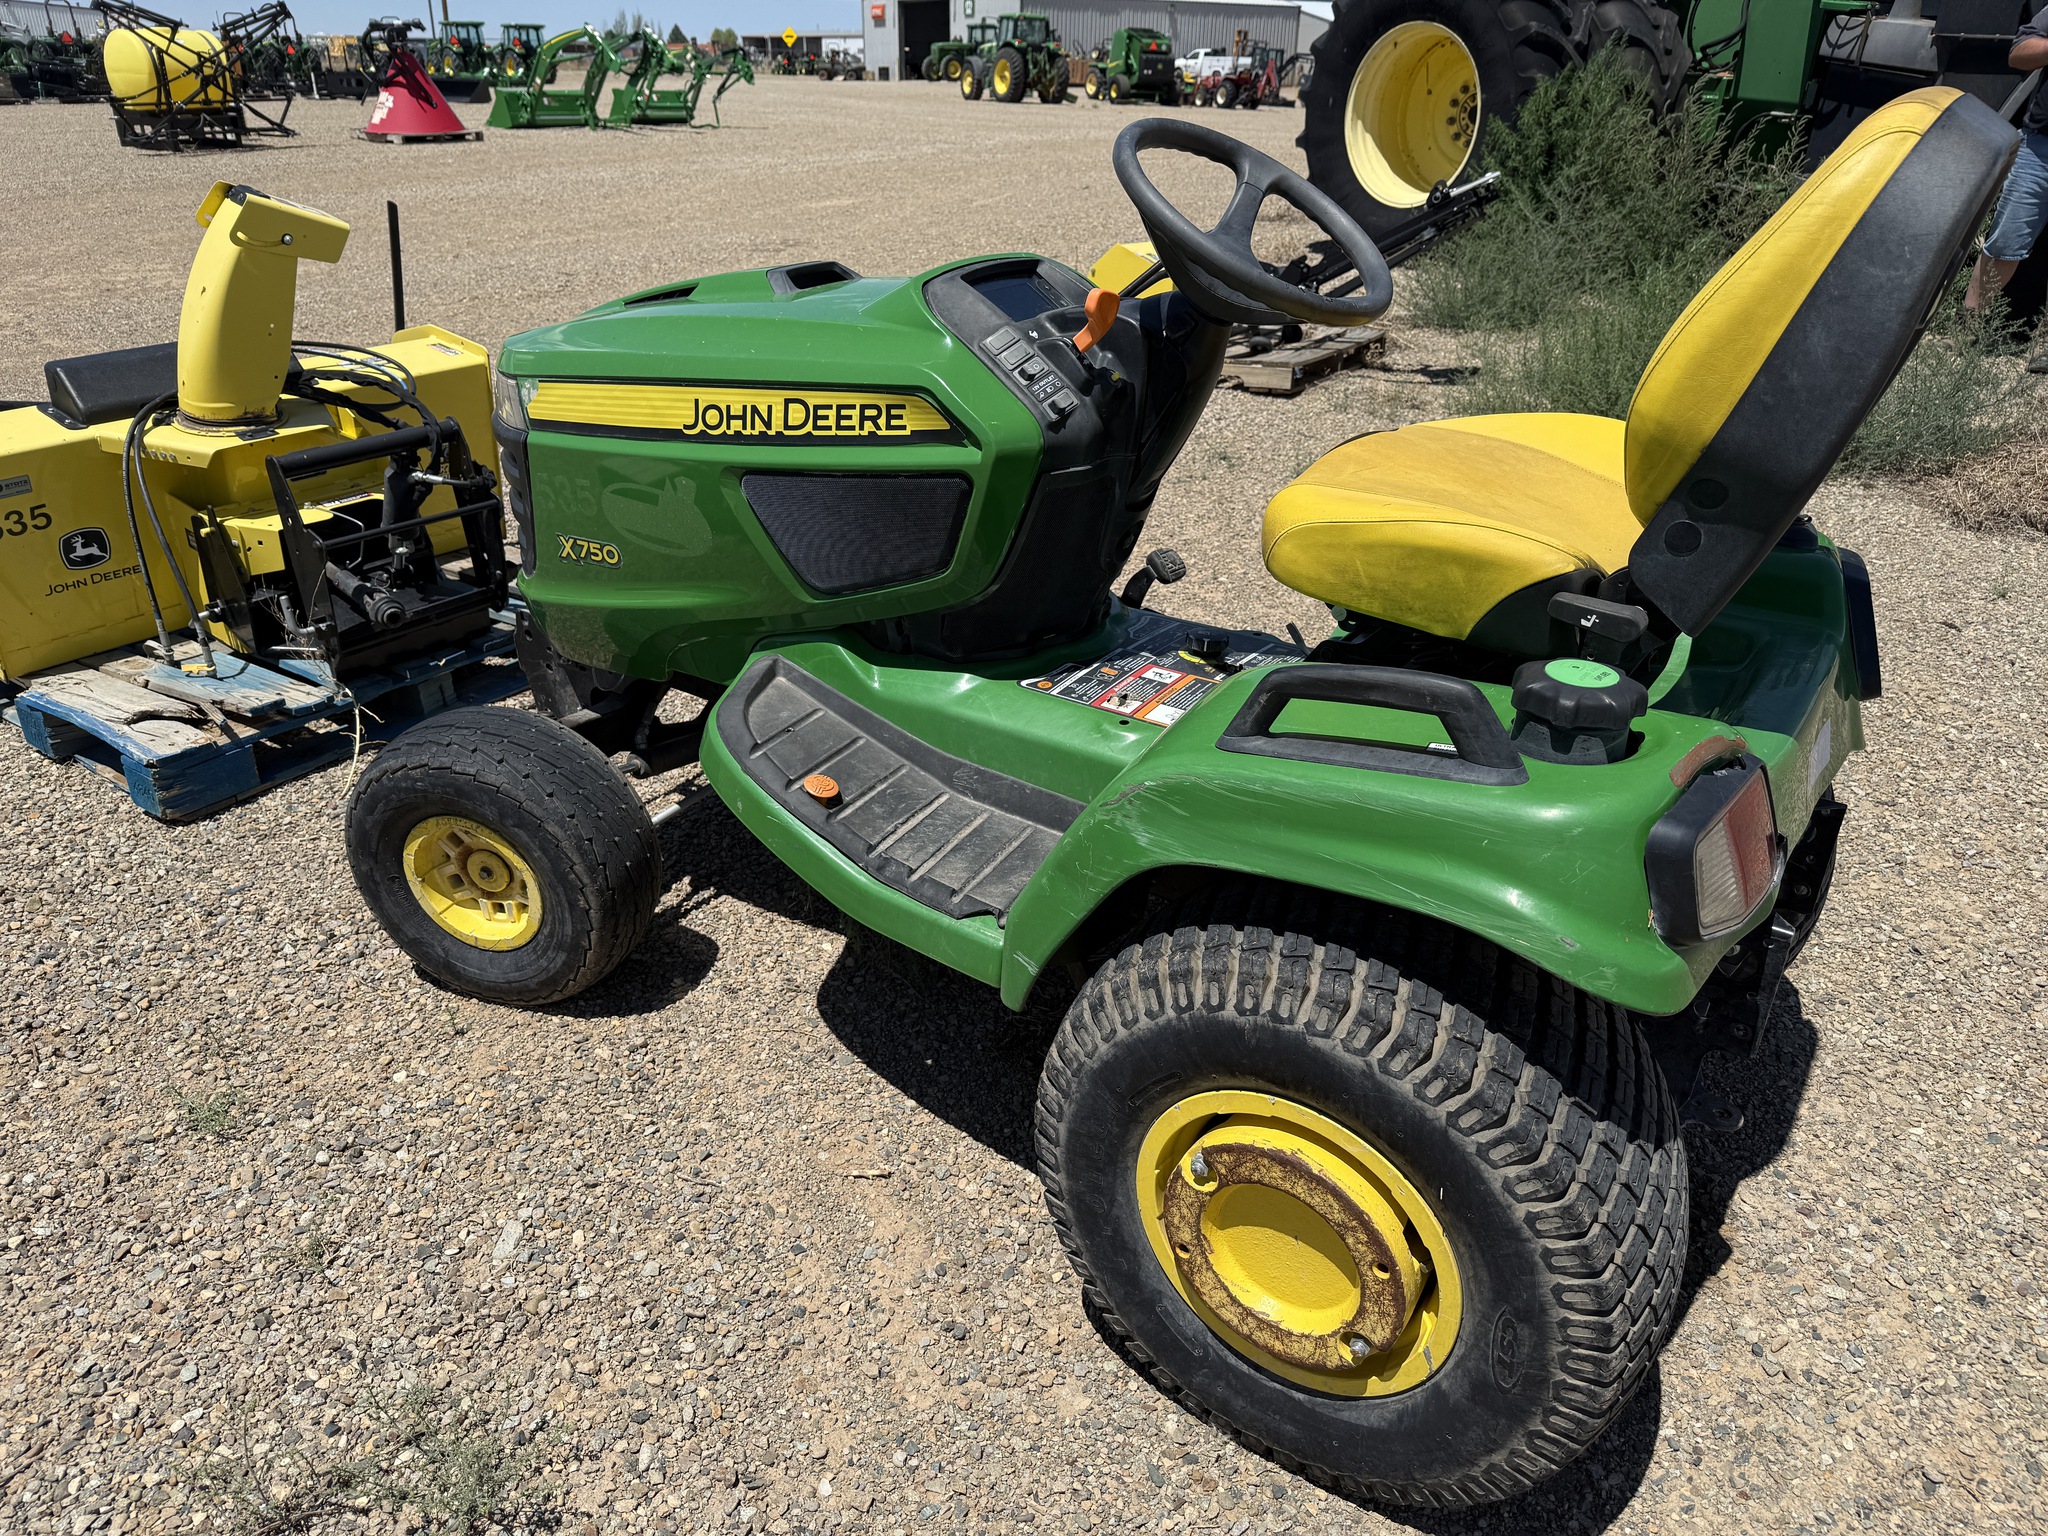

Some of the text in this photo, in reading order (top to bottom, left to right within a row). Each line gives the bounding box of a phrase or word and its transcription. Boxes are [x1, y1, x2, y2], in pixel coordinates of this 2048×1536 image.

[682, 397, 908, 432] JOHN DEERE
[0, 503, 52, 540] 35
[556, 534, 621, 566] X750
[45, 564, 143, 597] JOHN DEERE
[1498, 1314, 1518, 1381] CST
